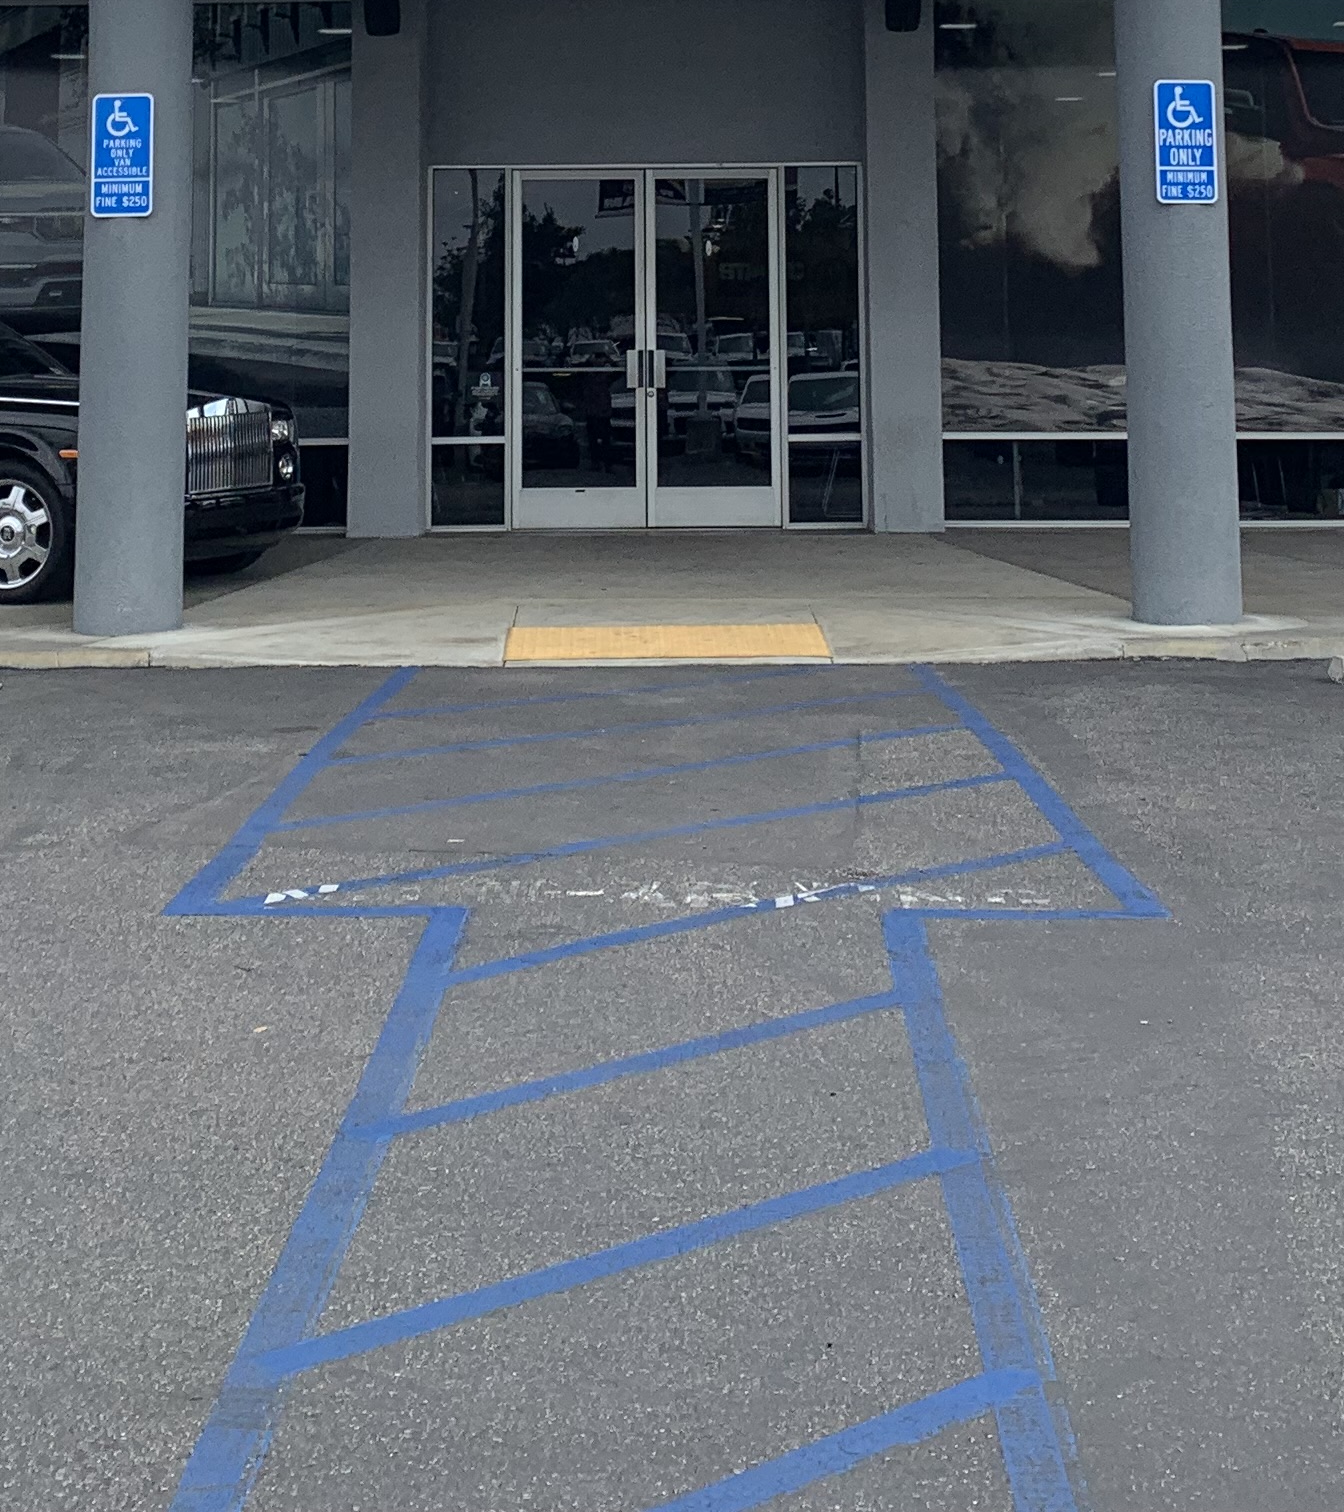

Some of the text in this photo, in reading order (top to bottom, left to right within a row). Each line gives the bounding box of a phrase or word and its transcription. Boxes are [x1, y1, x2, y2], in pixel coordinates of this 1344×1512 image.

[1159, 128, 1213, 146] PARKING
[102, 138, 142, 149] PARKING
[110, 148, 134, 158] ONLY
[1169, 148, 1203, 166] ONLY
[114, 158, 131, 166] VAN
[96, 166, 147, 176] ACCESSIBLE
[1166, 171, 1208, 184] MINIMUM
[101, 182, 143, 194] MINIMUM
[1162, 185, 1213, 198] FINE $250
[96, 196, 148, 208] FINE $250
